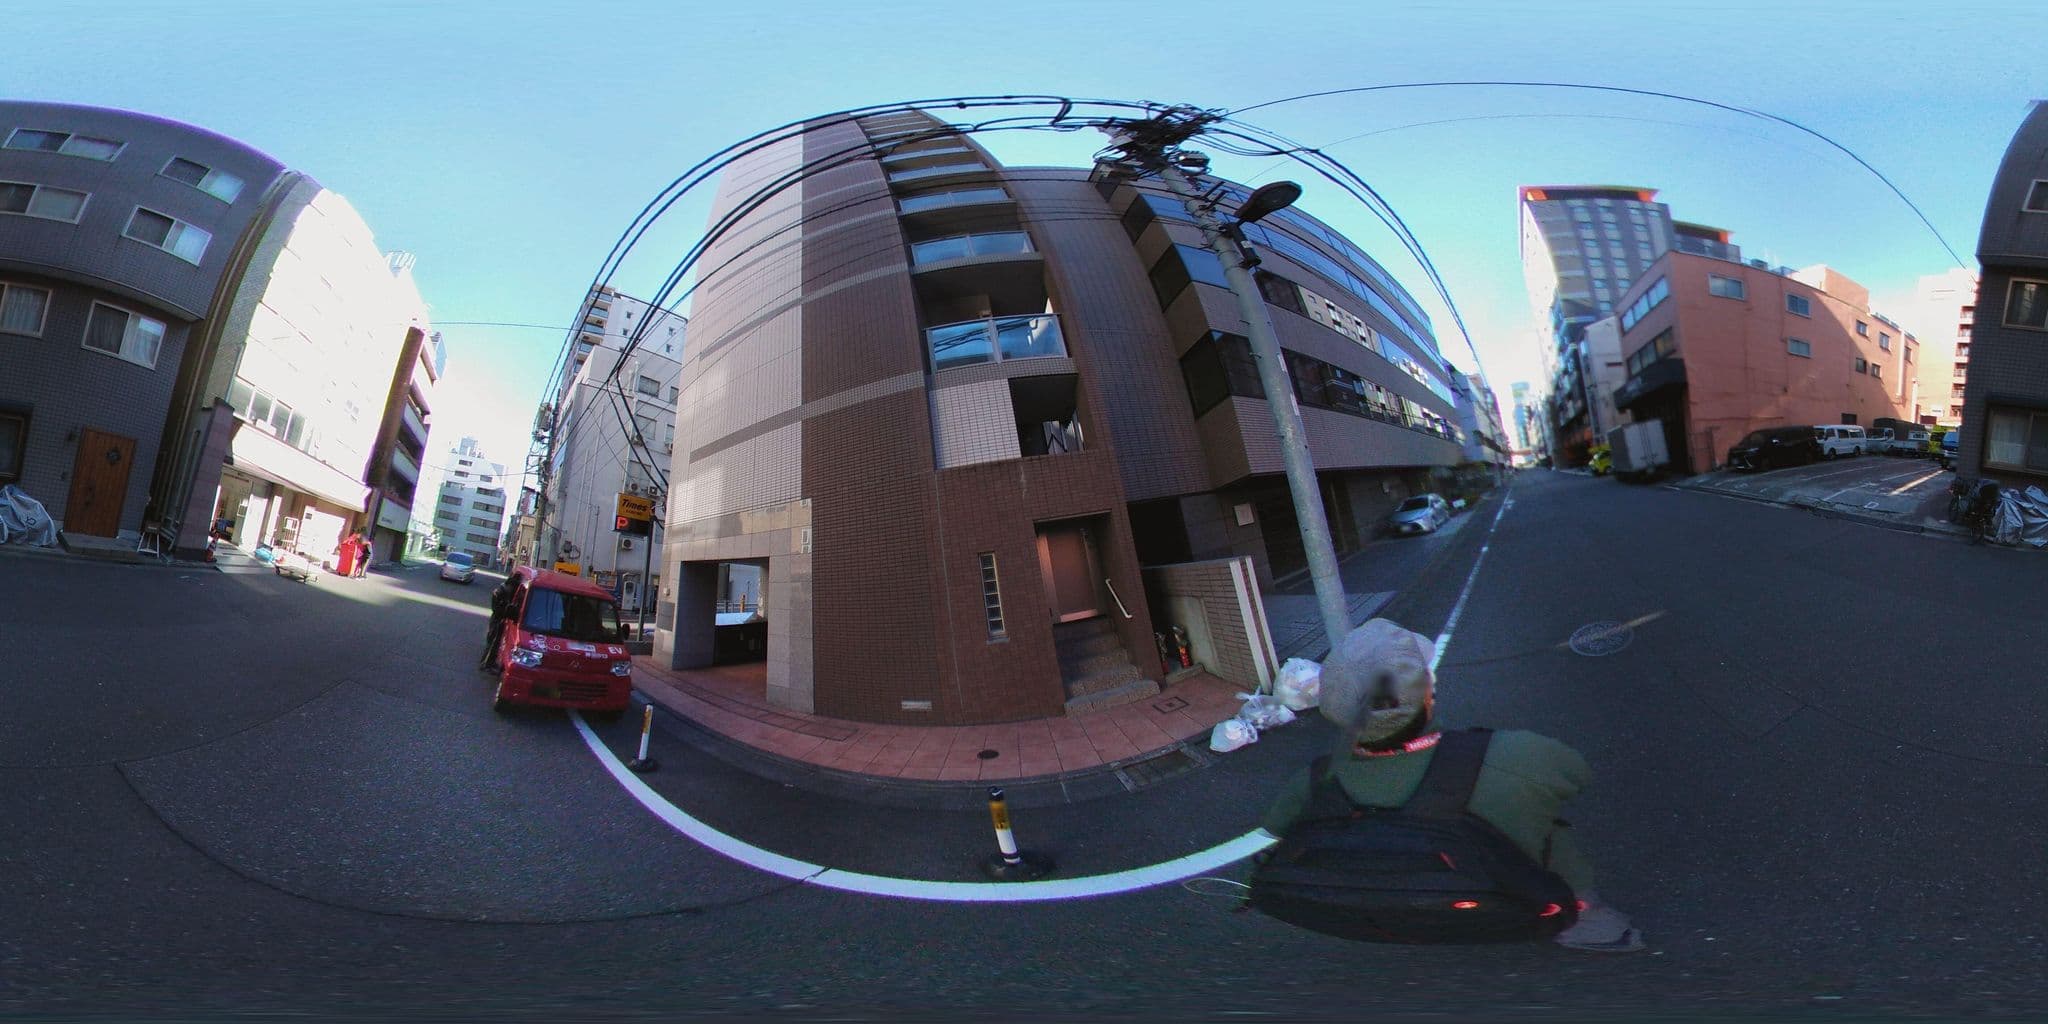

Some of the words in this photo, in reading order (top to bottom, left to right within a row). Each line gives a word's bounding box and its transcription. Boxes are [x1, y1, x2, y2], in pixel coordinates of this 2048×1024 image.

[622, 498, 647, 512] Times
[617, 516, 629, 530] P
[608, 646, 623, 655] EV
